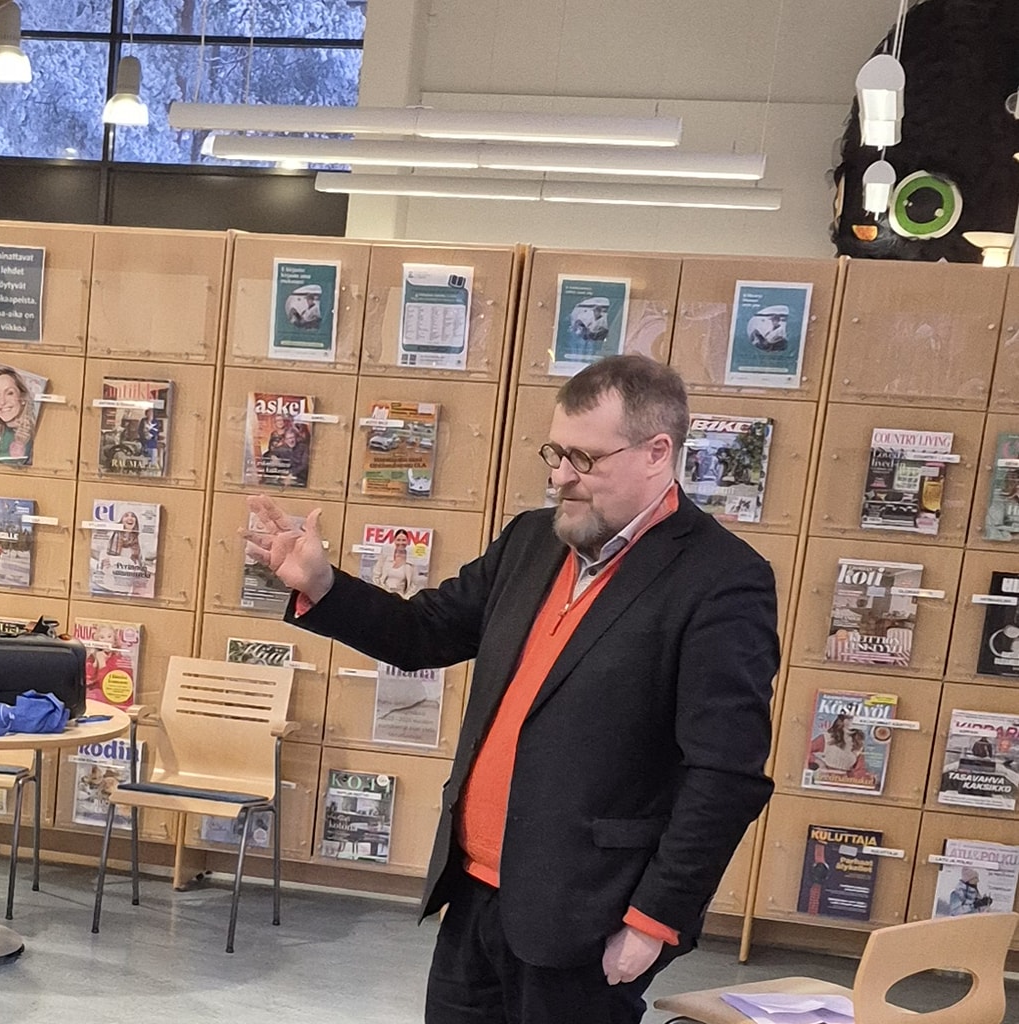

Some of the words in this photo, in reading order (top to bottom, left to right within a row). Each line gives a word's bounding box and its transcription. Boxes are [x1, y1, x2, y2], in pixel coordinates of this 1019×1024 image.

[0, 266, 24, 276] lehdet
[0, 323, 27, 332] viikkoa
[255, 397, 306, 416] askel
[691, 420, 752, 433] BIKE
[874, 432, 917, 446] COUNTRY
[919, 434, 951, 447] LIVING
[95, 504, 115, 521] et
[818, 699, 891, 719] Käsityöt
[948, 772, 1005, 785] TASAVAHVA
[962, 782, 1012, 793] KAKSIKKO
[811, 829, 877, 847] KULUTTAJA
